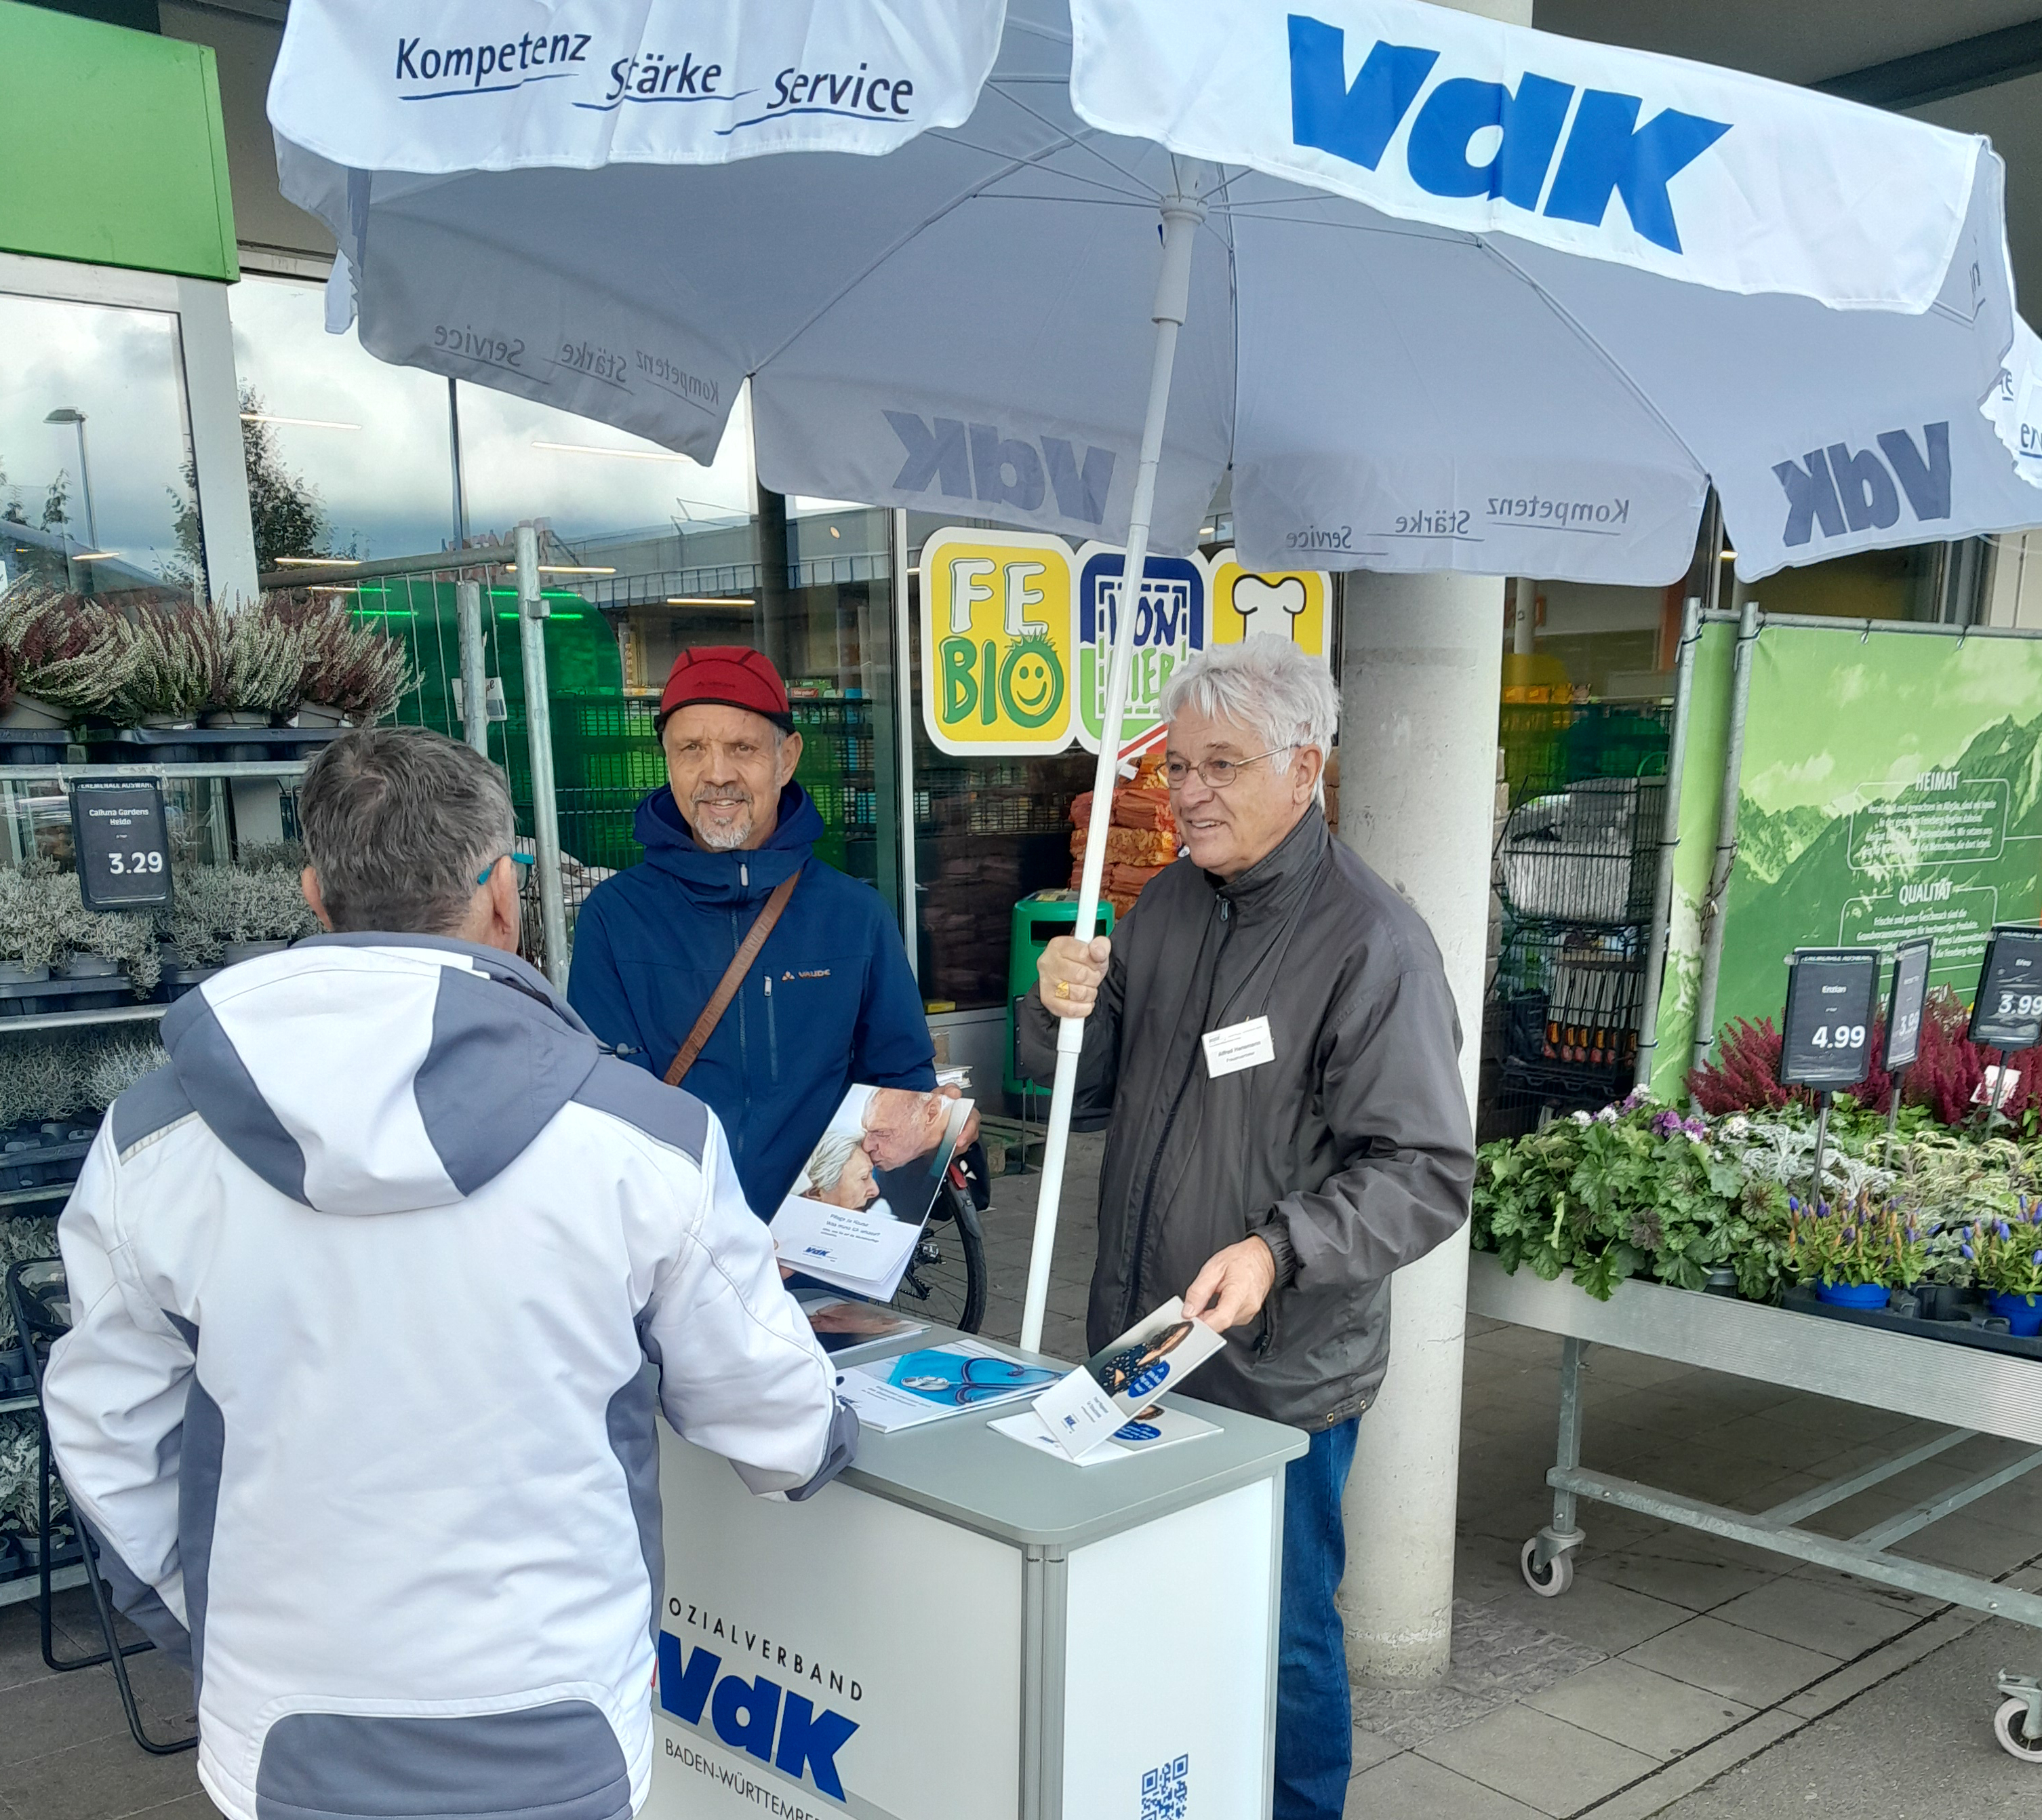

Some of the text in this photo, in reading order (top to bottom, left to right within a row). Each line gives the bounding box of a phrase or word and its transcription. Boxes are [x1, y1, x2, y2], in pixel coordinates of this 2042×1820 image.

[396, 32, 913, 115] Kompetenz Stärke Service
[1287, 14, 1734, 254] VdK
[949, 557, 1047, 635] FE
[939, 635, 1064, 729] BIO
[1916, 771, 1960, 791] HEIMAT
[108, 851, 163, 875] 3.29
[1900, 877, 1953, 906] QUALITÄT
[798, 968, 831, 978] VAUDE
[1999, 994, 2042, 1016] 3.99
[1811, 1025, 1866, 1048] 4.99
[669, 1597, 863, 1701] OZIALVERBAND
